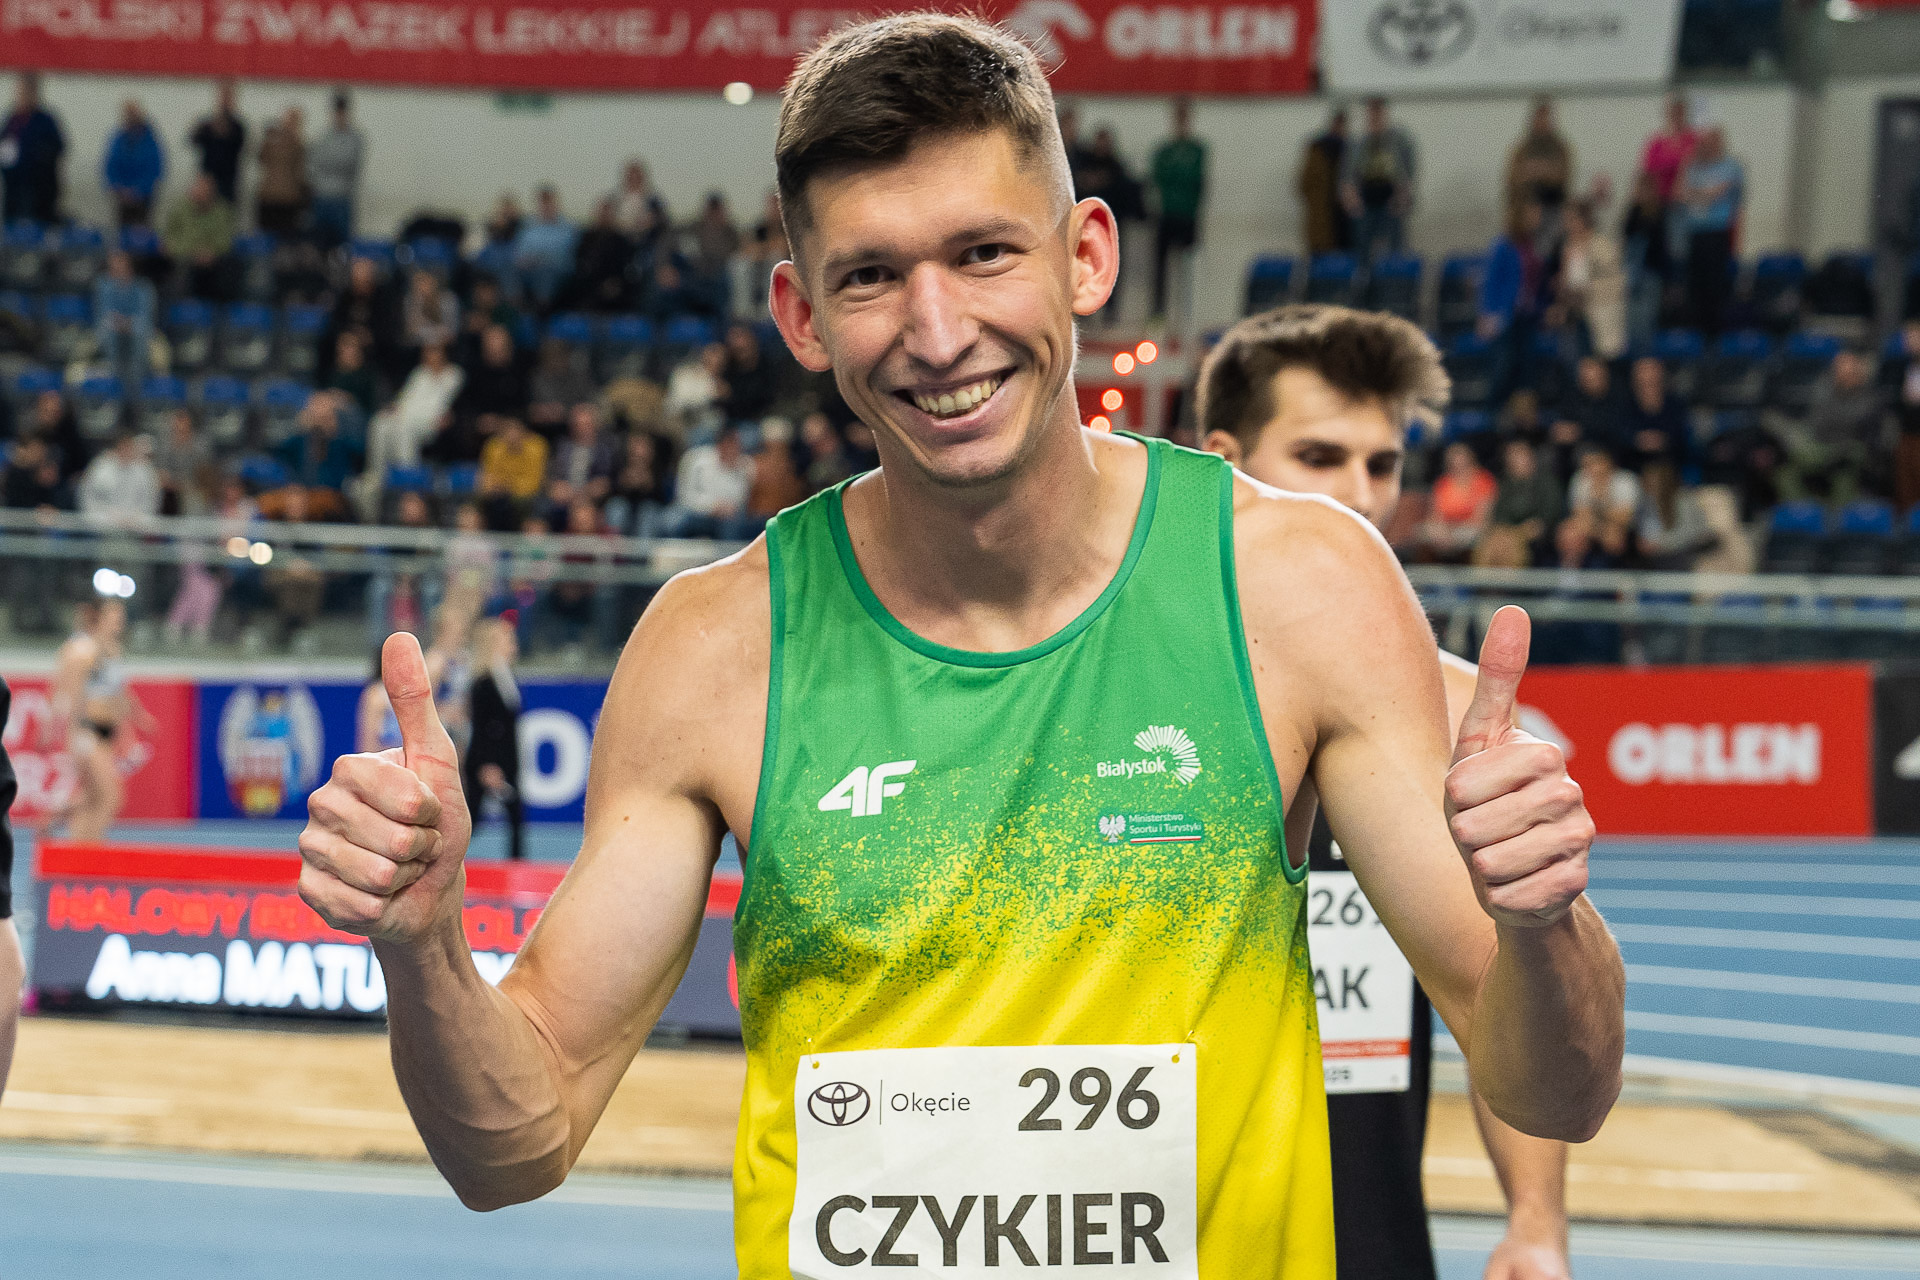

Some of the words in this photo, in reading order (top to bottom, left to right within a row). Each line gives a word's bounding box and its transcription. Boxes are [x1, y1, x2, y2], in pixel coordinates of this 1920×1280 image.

[1105, 6, 1298, 59] ORLEN
[1097, 756, 1167, 779] Białystok
[1608, 722, 1822, 785] ORLEN
[818, 760, 917, 817] 4F
[1128, 813, 1184, 823] Ministerstwo
[1129, 824, 1159, 834] Sportu
[1164, 822, 1202, 833] Turystyki
[1311, 888, 1382, 926] 26
[223, 939, 388, 1012] MATU
[1314, 966, 1370, 1010] AK
[890, 1091, 971, 1116] Okęcie
[1018, 1066, 1160, 1131] 296
[815, 1192, 1170, 1267] CZYKIER
